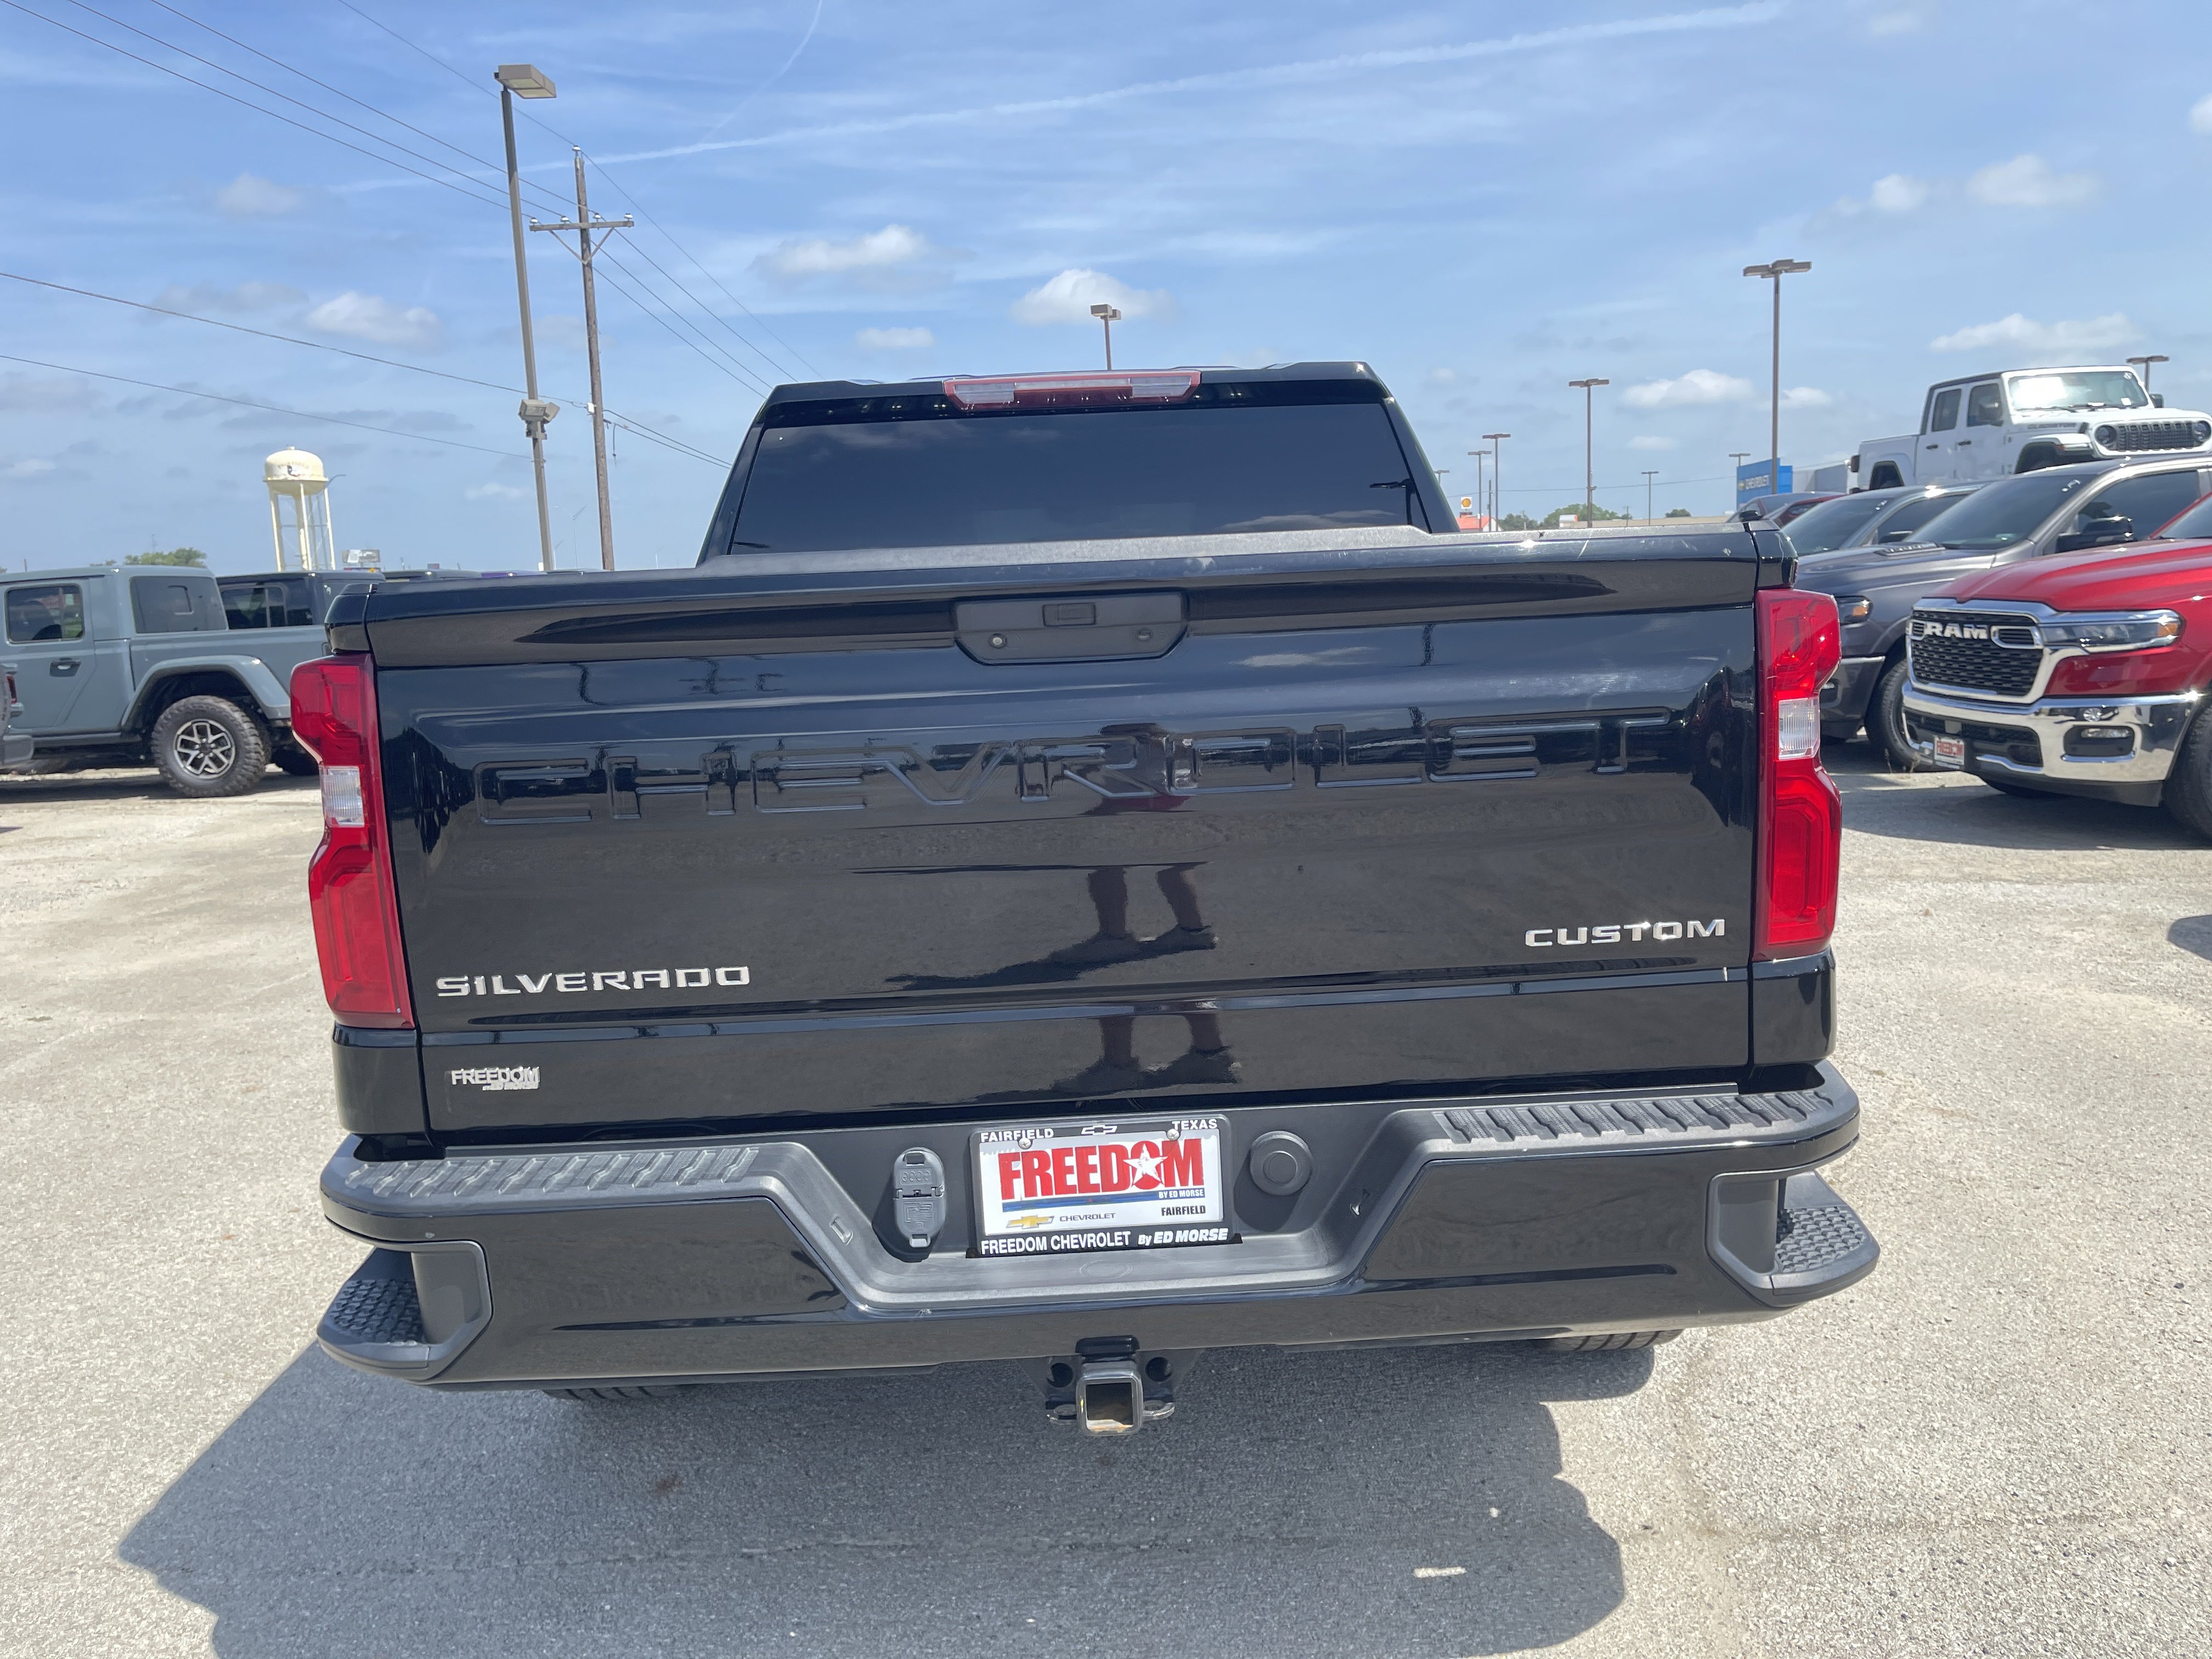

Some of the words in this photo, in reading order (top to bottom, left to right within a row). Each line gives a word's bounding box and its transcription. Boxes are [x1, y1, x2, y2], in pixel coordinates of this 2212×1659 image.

[1923, 621, 1988, 639] RAM
[476, 706, 1670, 826] CHEVROLET
[1525, 918, 1725, 947] CUSTOM
[436, 966, 750, 997] SILVERADO
[452, 1066, 540, 1085] FREEDOM
[1172, 1118, 1217, 1131] TEXAS
[980, 1128, 1054, 1143] FAIRFIELD
[998, 1138, 1204, 1200] FREEDOM
[1169, 1190, 1178, 1198] ED
[1179, 1189, 1204, 1197] MORSE
[1059, 1212, 1116, 1222] CHEVROLET
[1161, 1205, 1206, 1216] FAIRFIELD
[981, 1236, 1047, 1255] FREEDOM
[1051, 1231, 1131, 1250] CHEVROLET
[1138, 1234, 1152, 1246] By
[1153, 1231, 1173, 1244] ED
[1175, 1228, 1228, 1243] MORSE
